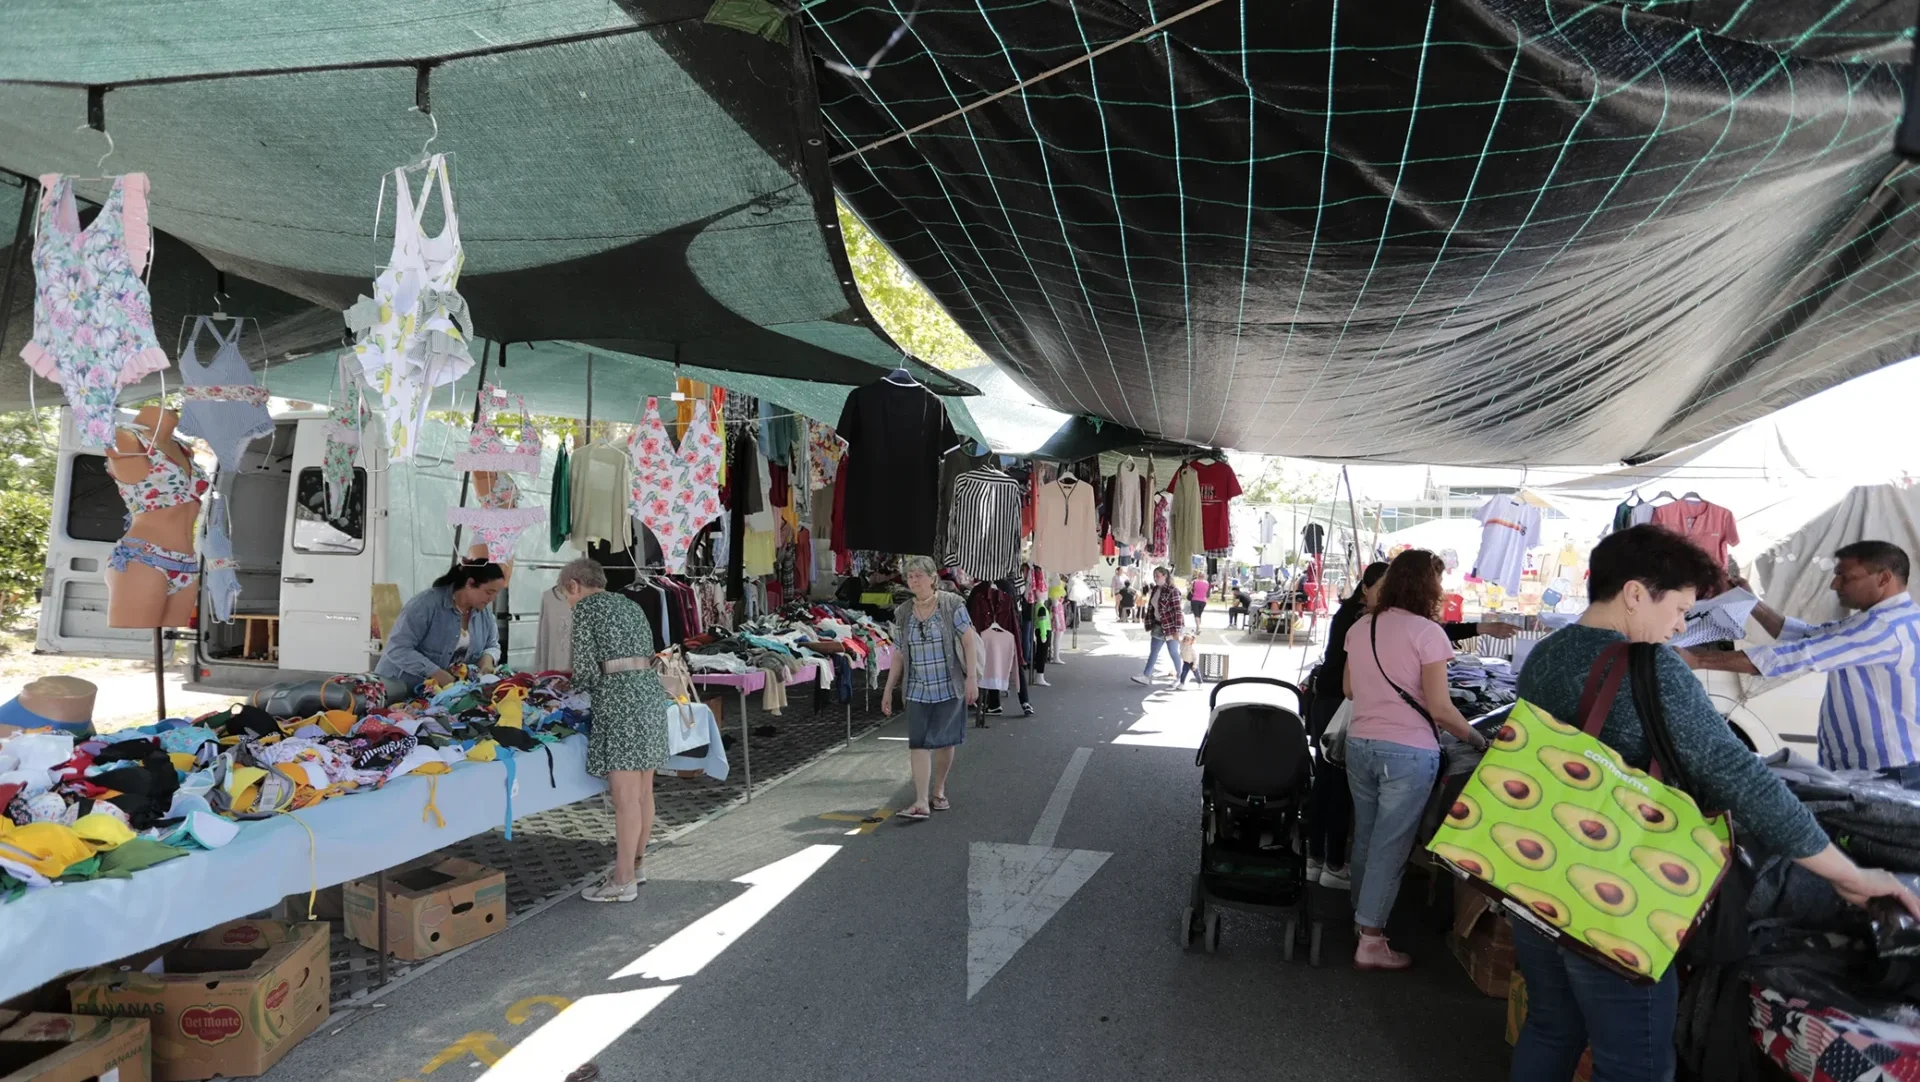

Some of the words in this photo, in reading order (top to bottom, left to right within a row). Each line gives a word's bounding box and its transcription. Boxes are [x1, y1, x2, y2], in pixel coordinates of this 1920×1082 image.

[76, 1002, 165, 1017] BANANAS
[184, 1017, 202, 1028] Del
[203, 1016, 240, 1028] Monte
